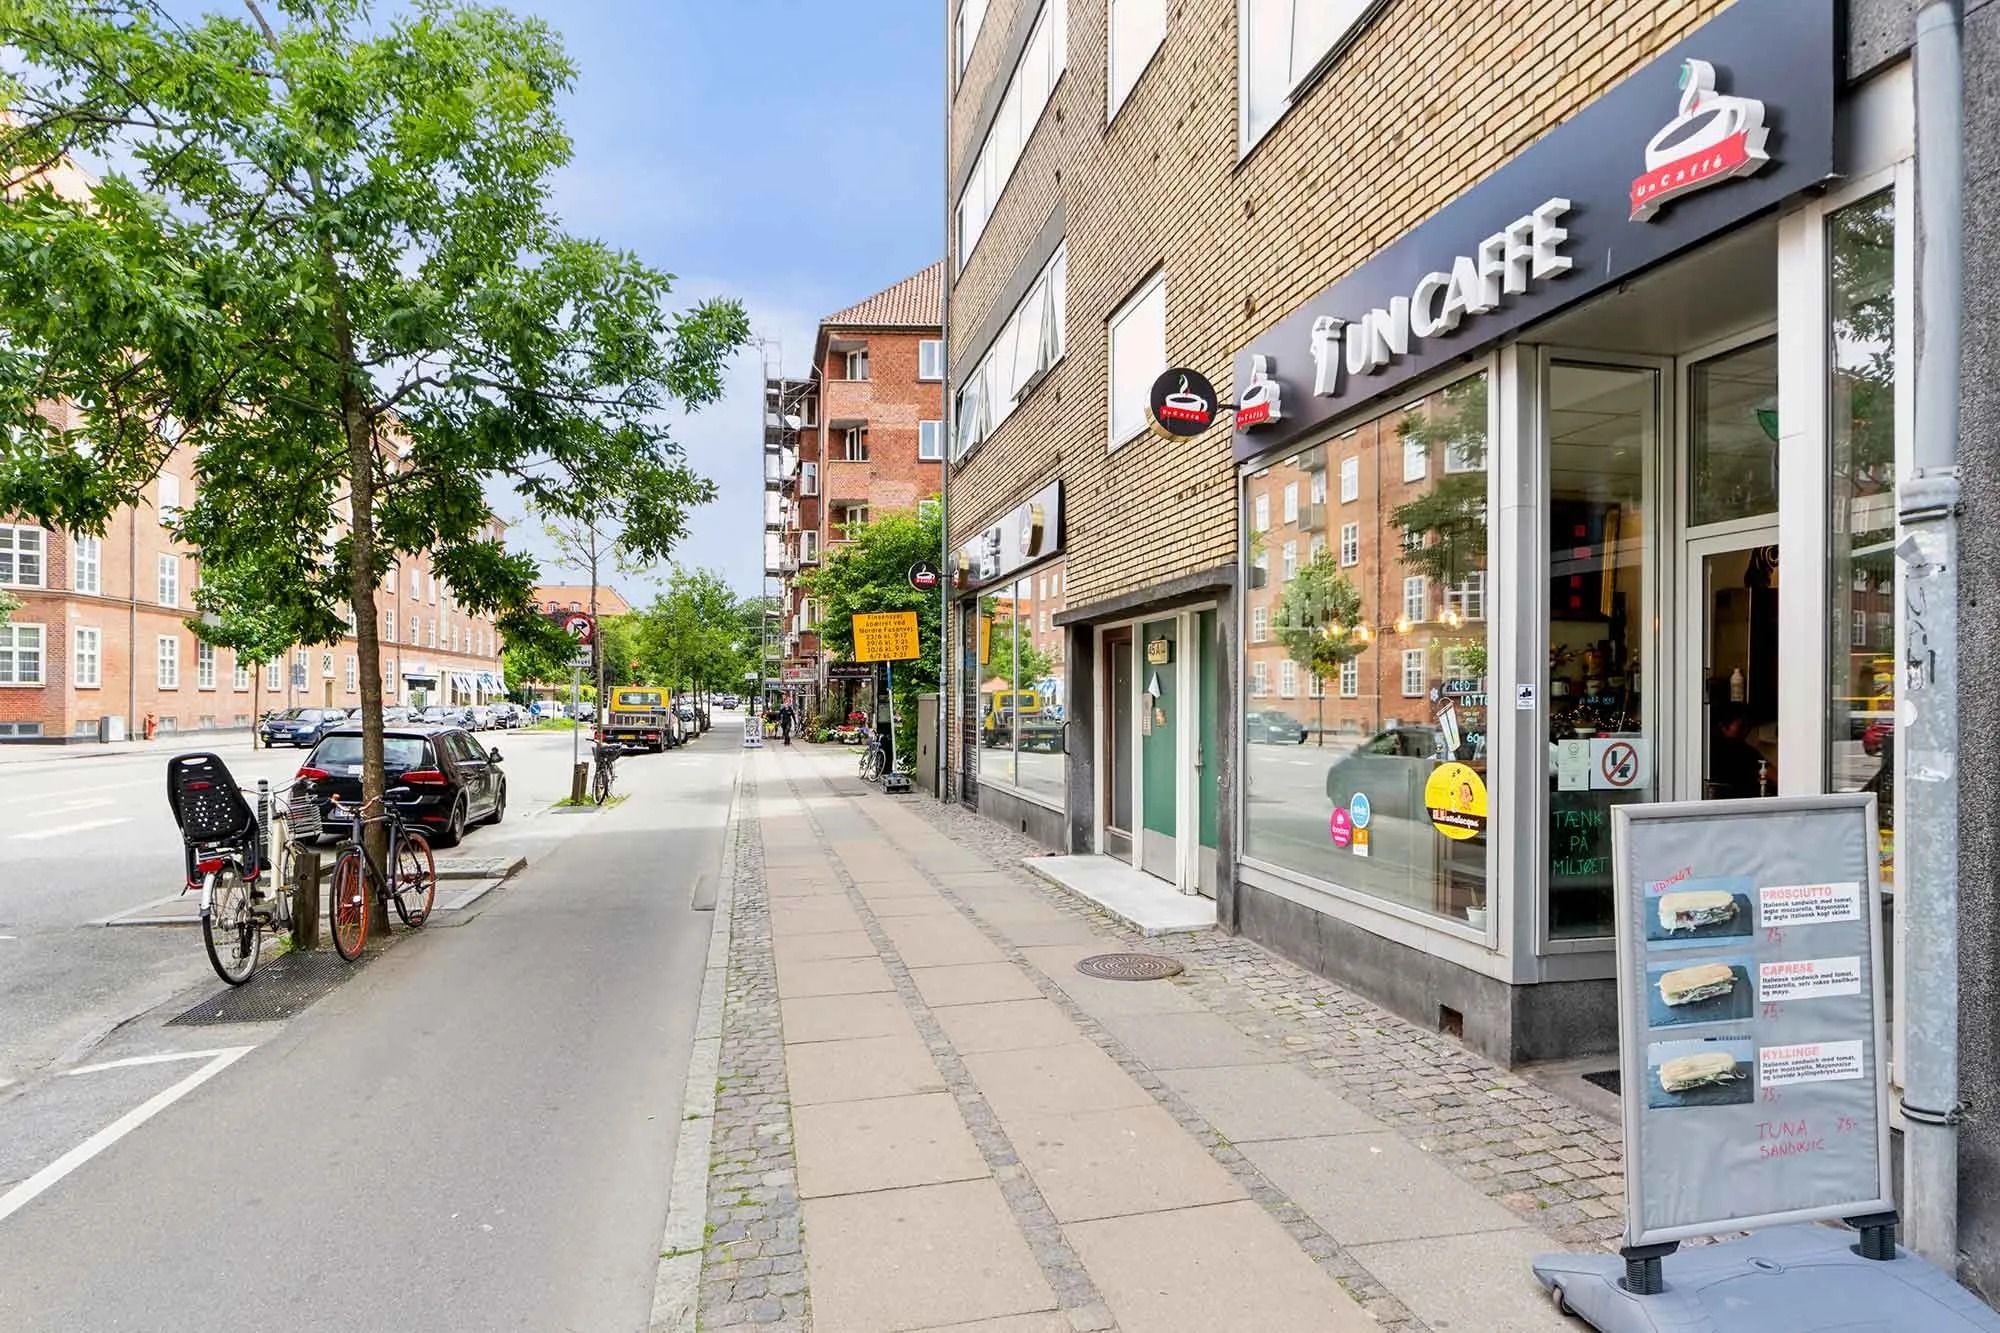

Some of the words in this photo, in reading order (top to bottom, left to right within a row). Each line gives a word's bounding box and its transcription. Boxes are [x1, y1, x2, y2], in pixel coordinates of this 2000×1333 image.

[1569, 829, 1589, 853] PÅ
[1762, 886, 1832, 899] PROSCIUTTO
[1762, 963, 1815, 976] CAPRESE
[1755, 1119, 1808, 1140] TUNA
